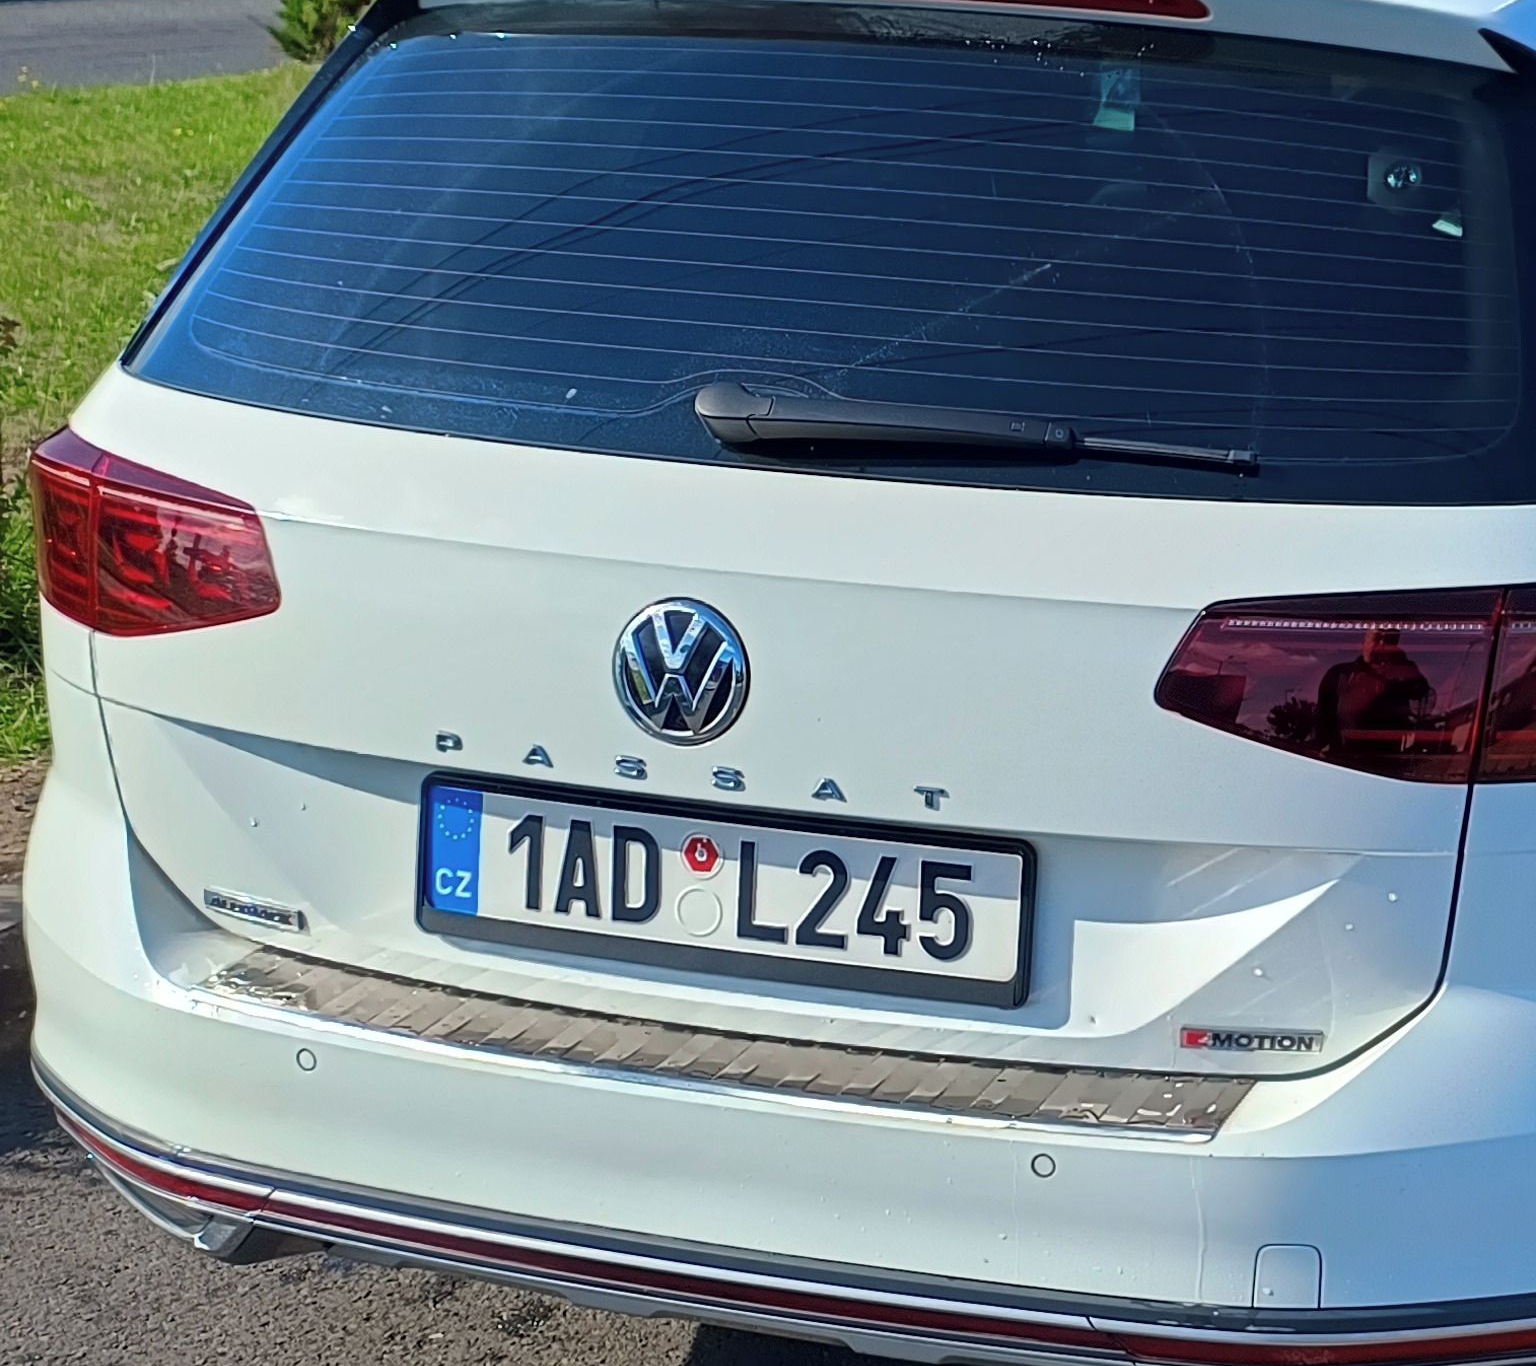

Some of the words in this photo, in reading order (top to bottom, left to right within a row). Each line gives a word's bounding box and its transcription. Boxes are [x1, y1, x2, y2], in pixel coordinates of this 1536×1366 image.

[435, 730, 951, 811] PASSAT
[435, 866, 472, 900] CZ
[507, 814, 661, 923] 1AD
[736, 839, 974, 961] L245
